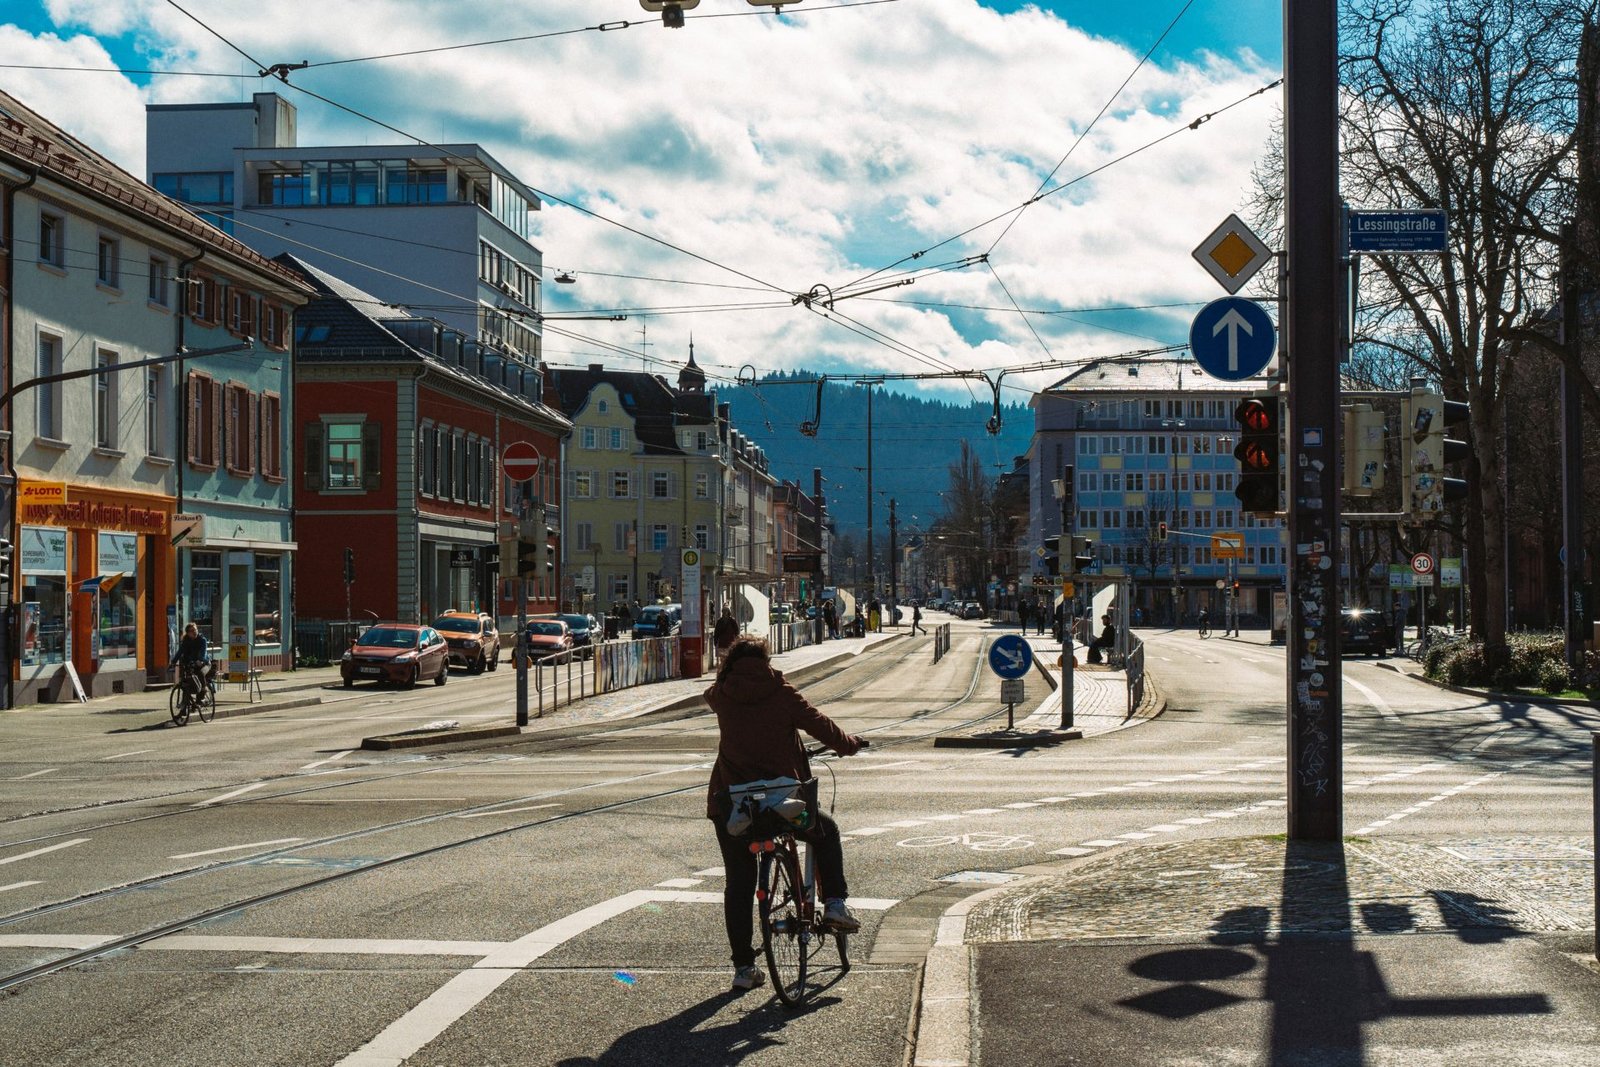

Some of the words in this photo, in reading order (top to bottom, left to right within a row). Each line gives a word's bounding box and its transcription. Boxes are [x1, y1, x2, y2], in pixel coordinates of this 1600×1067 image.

[1358, 217, 1436, 234] Lessingstraße
[34, 487, 62, 495] LOTTO
[1416, 559, 1429, 569] 30
